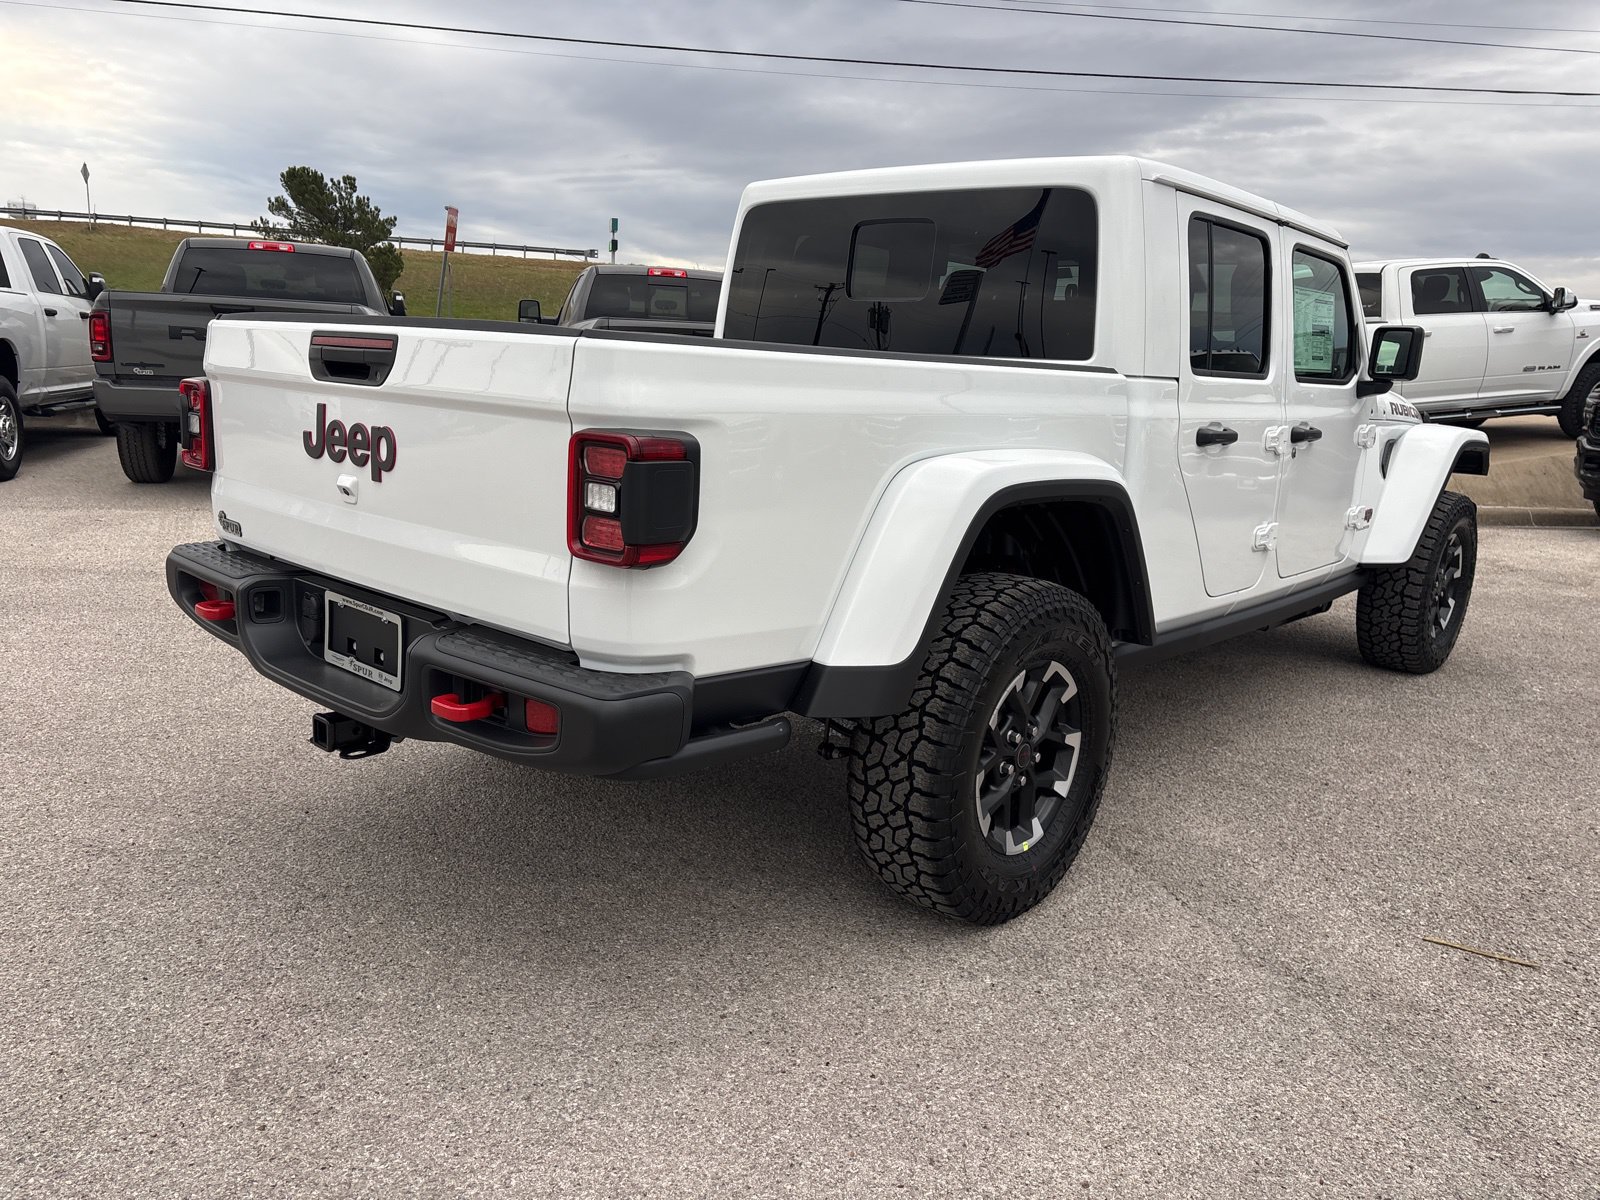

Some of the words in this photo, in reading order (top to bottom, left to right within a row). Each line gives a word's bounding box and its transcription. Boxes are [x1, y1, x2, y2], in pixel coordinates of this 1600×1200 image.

[303, 403, 397, 483] Jeep
[222, 518, 241, 536] SPUR
[353, 663, 373, 679] SPUR
